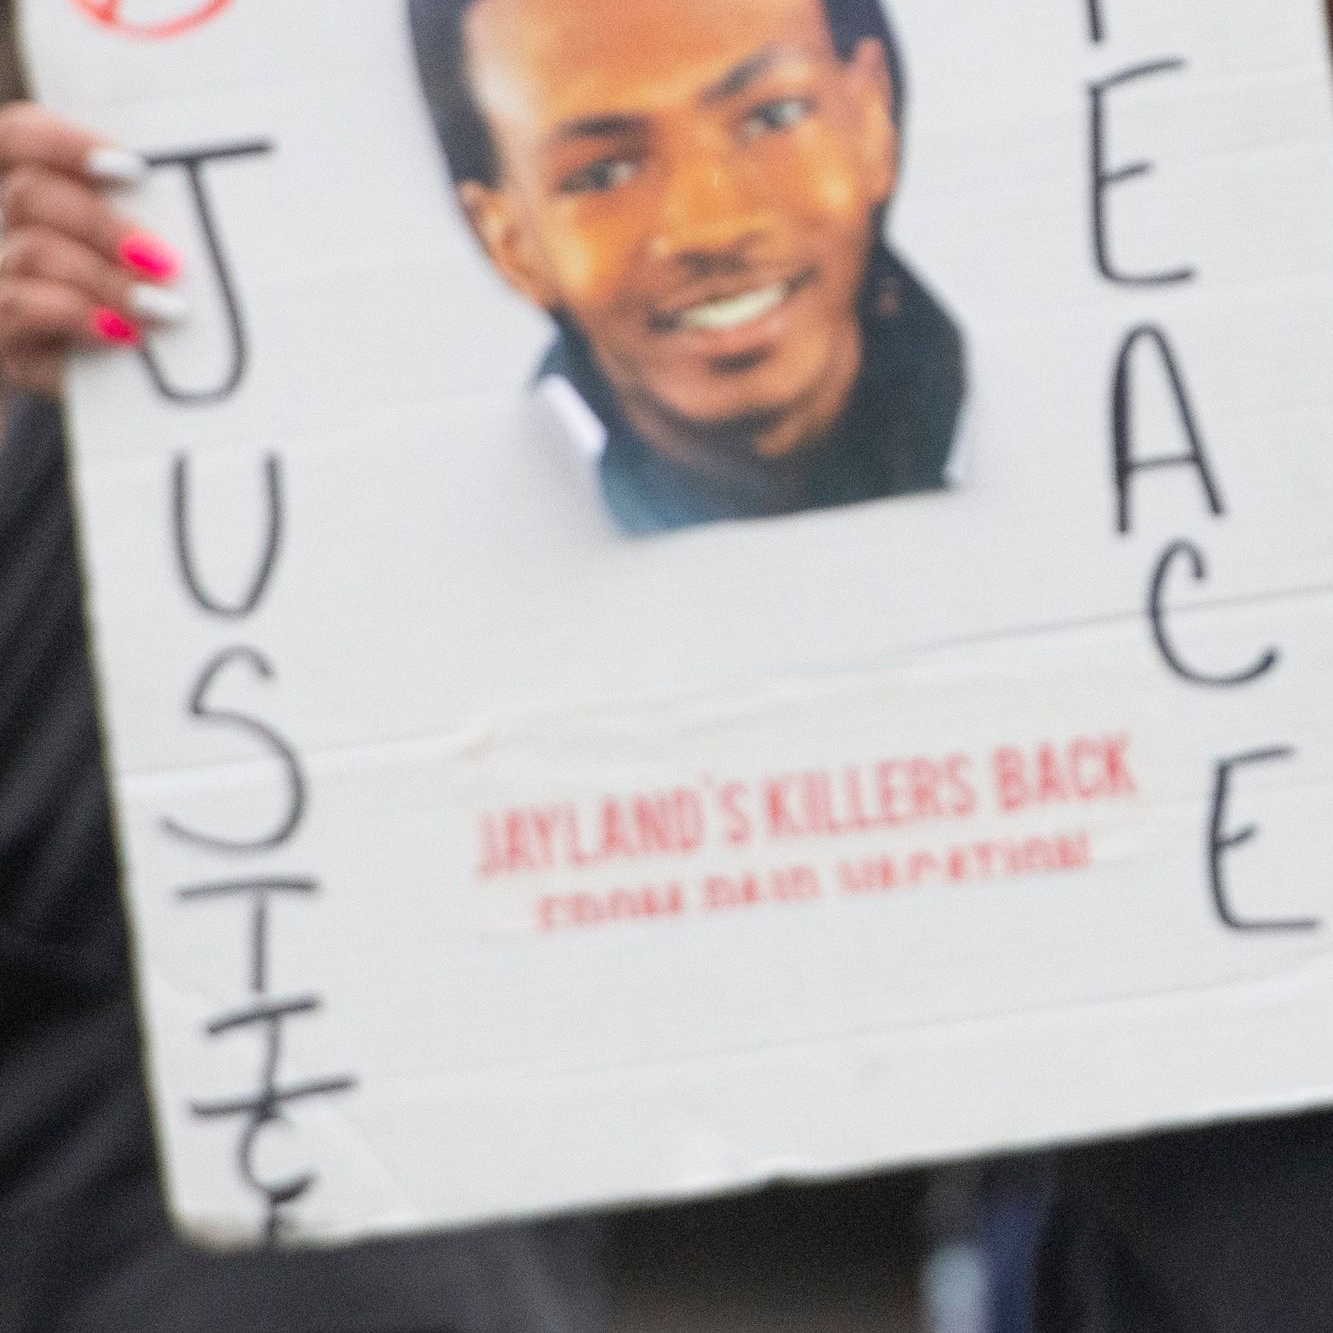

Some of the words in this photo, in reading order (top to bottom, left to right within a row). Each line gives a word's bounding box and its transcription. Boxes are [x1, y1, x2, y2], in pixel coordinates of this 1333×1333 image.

[476, 773, 752, 884] JAYLAND'S
[762, 752, 979, 841] KILLERS
[991, 730, 1137, 815] BACK
